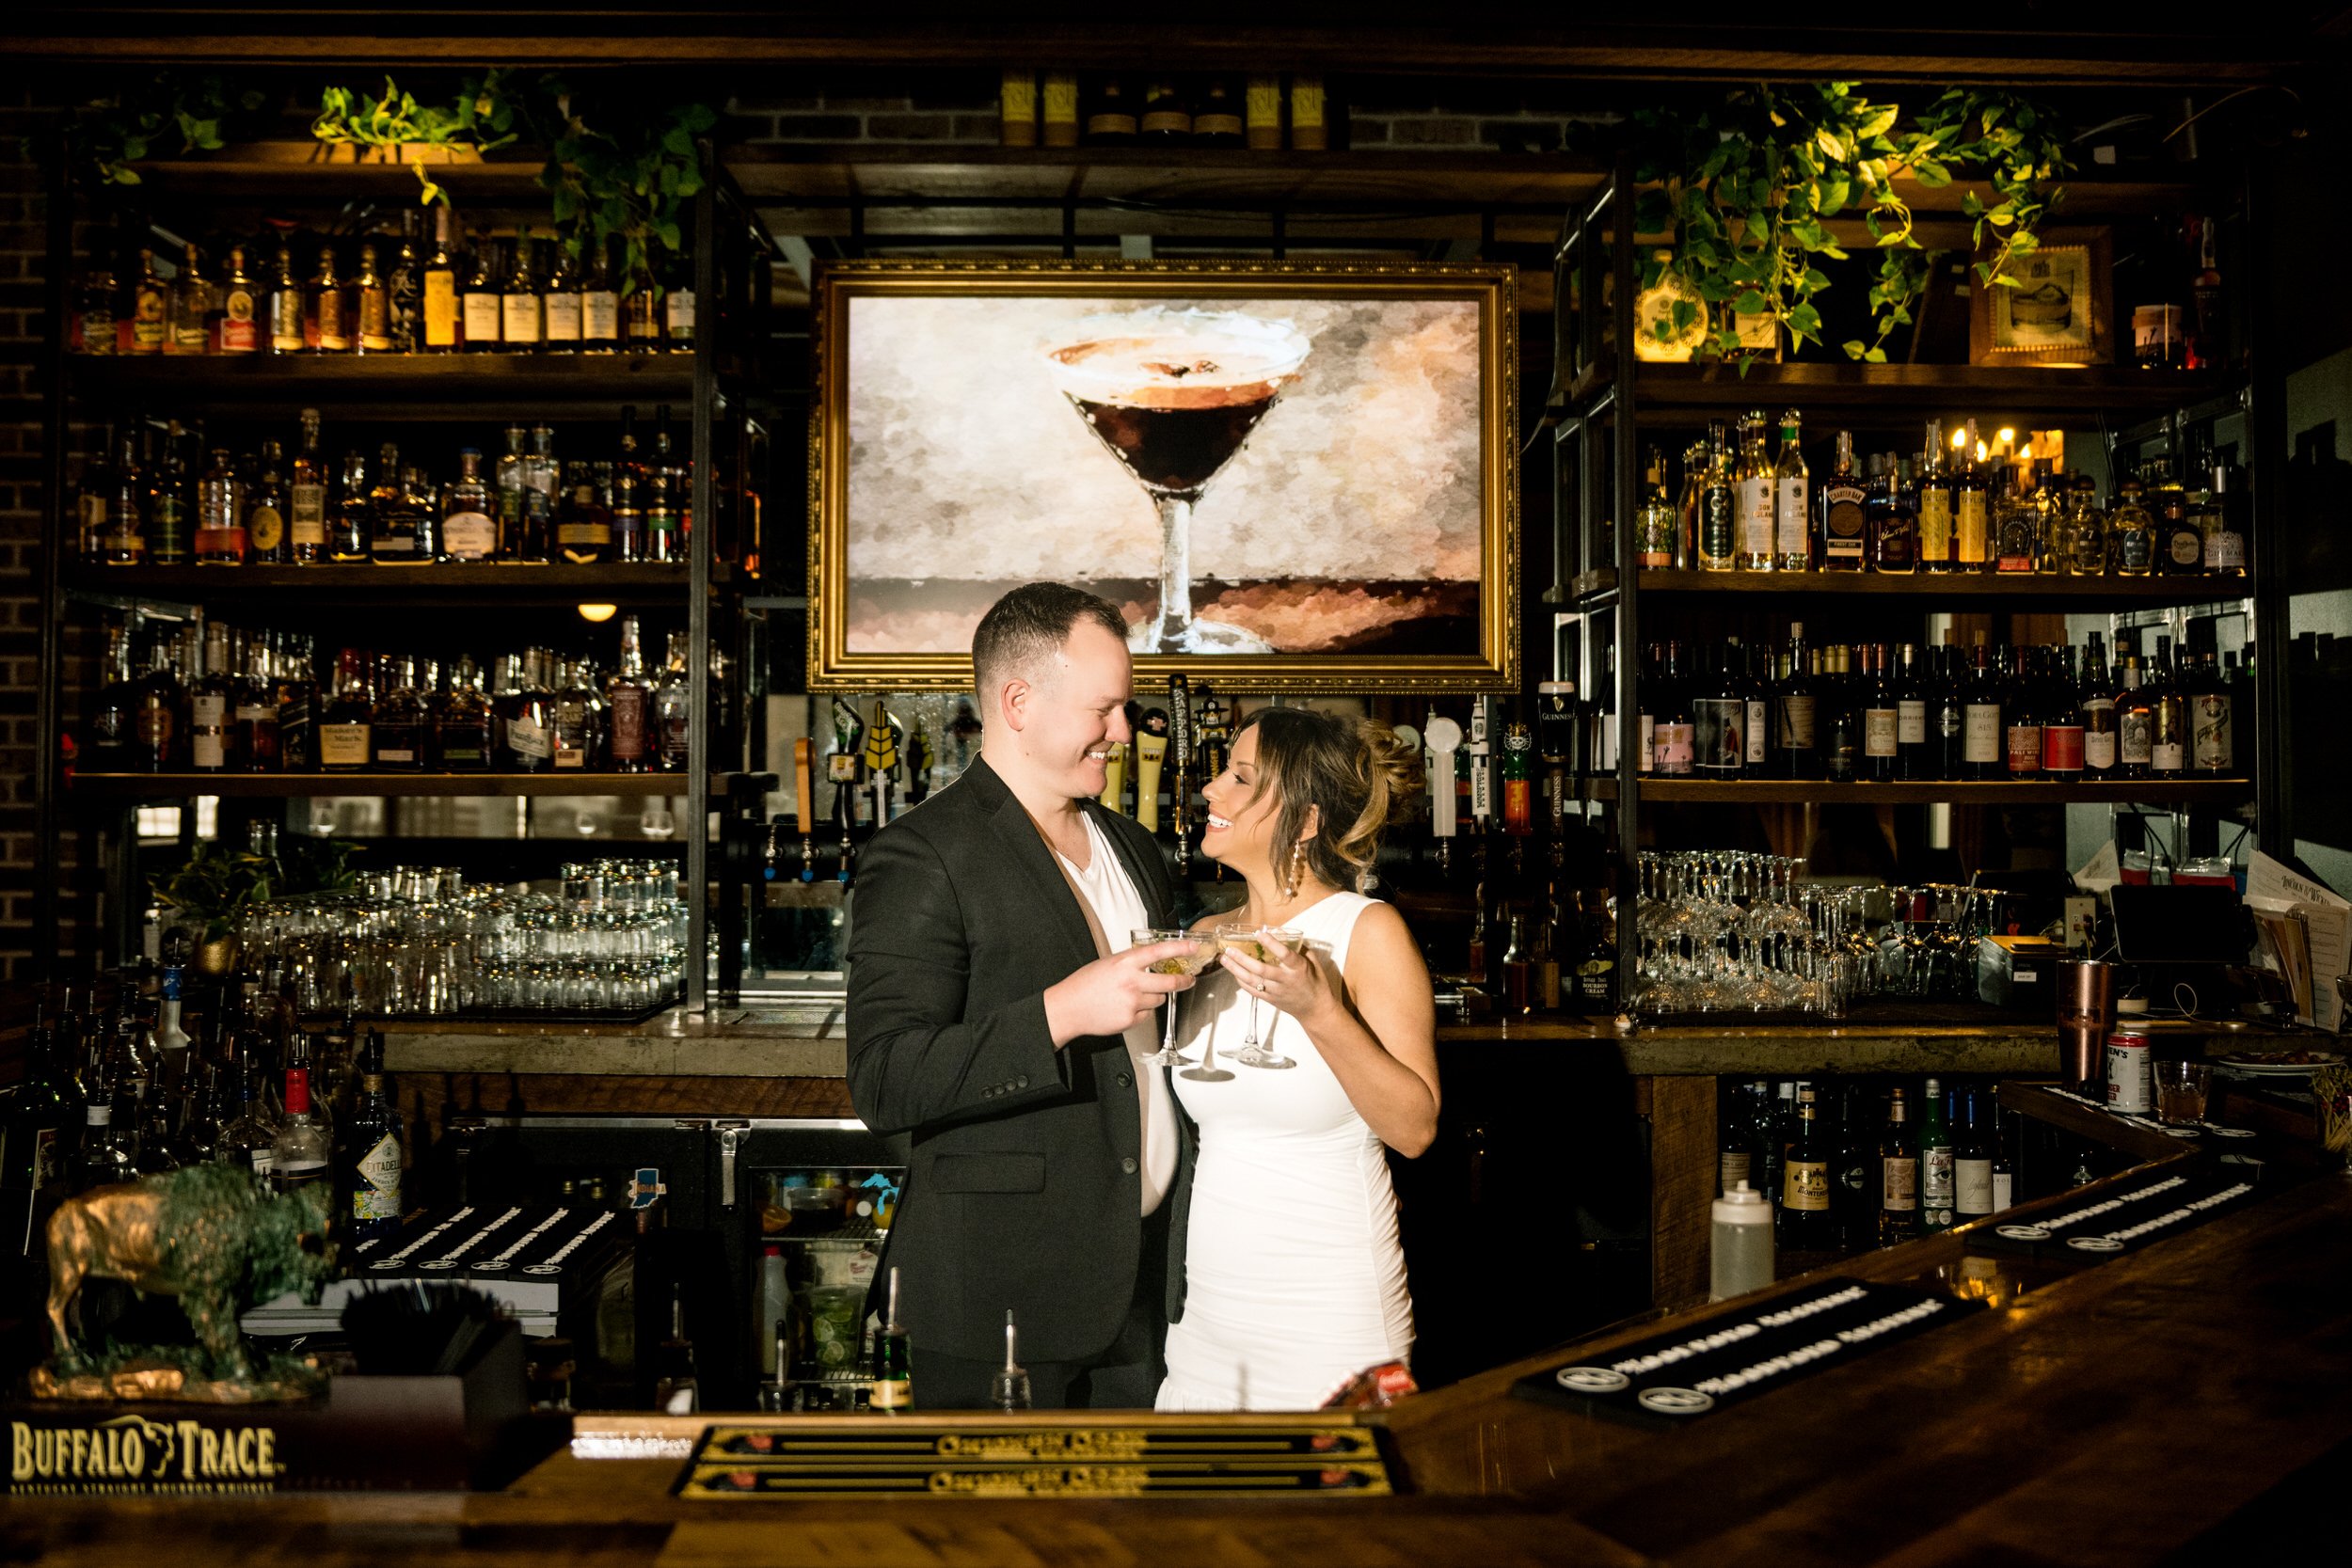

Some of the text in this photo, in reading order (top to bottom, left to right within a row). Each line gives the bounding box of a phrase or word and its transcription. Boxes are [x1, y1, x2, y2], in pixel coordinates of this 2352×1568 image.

[1923, 494, 1948, 502] TAYLOR
[1961, 496, 1985, 504] TAYLOR
[1176, 689, 1189, 758] SAPPORO
[1542, 712, 1573, 721] GUINNESS
[1552, 775, 1562, 817] GUINNESS
[11, 1420, 276, 1482] BUFFALO TRACE
